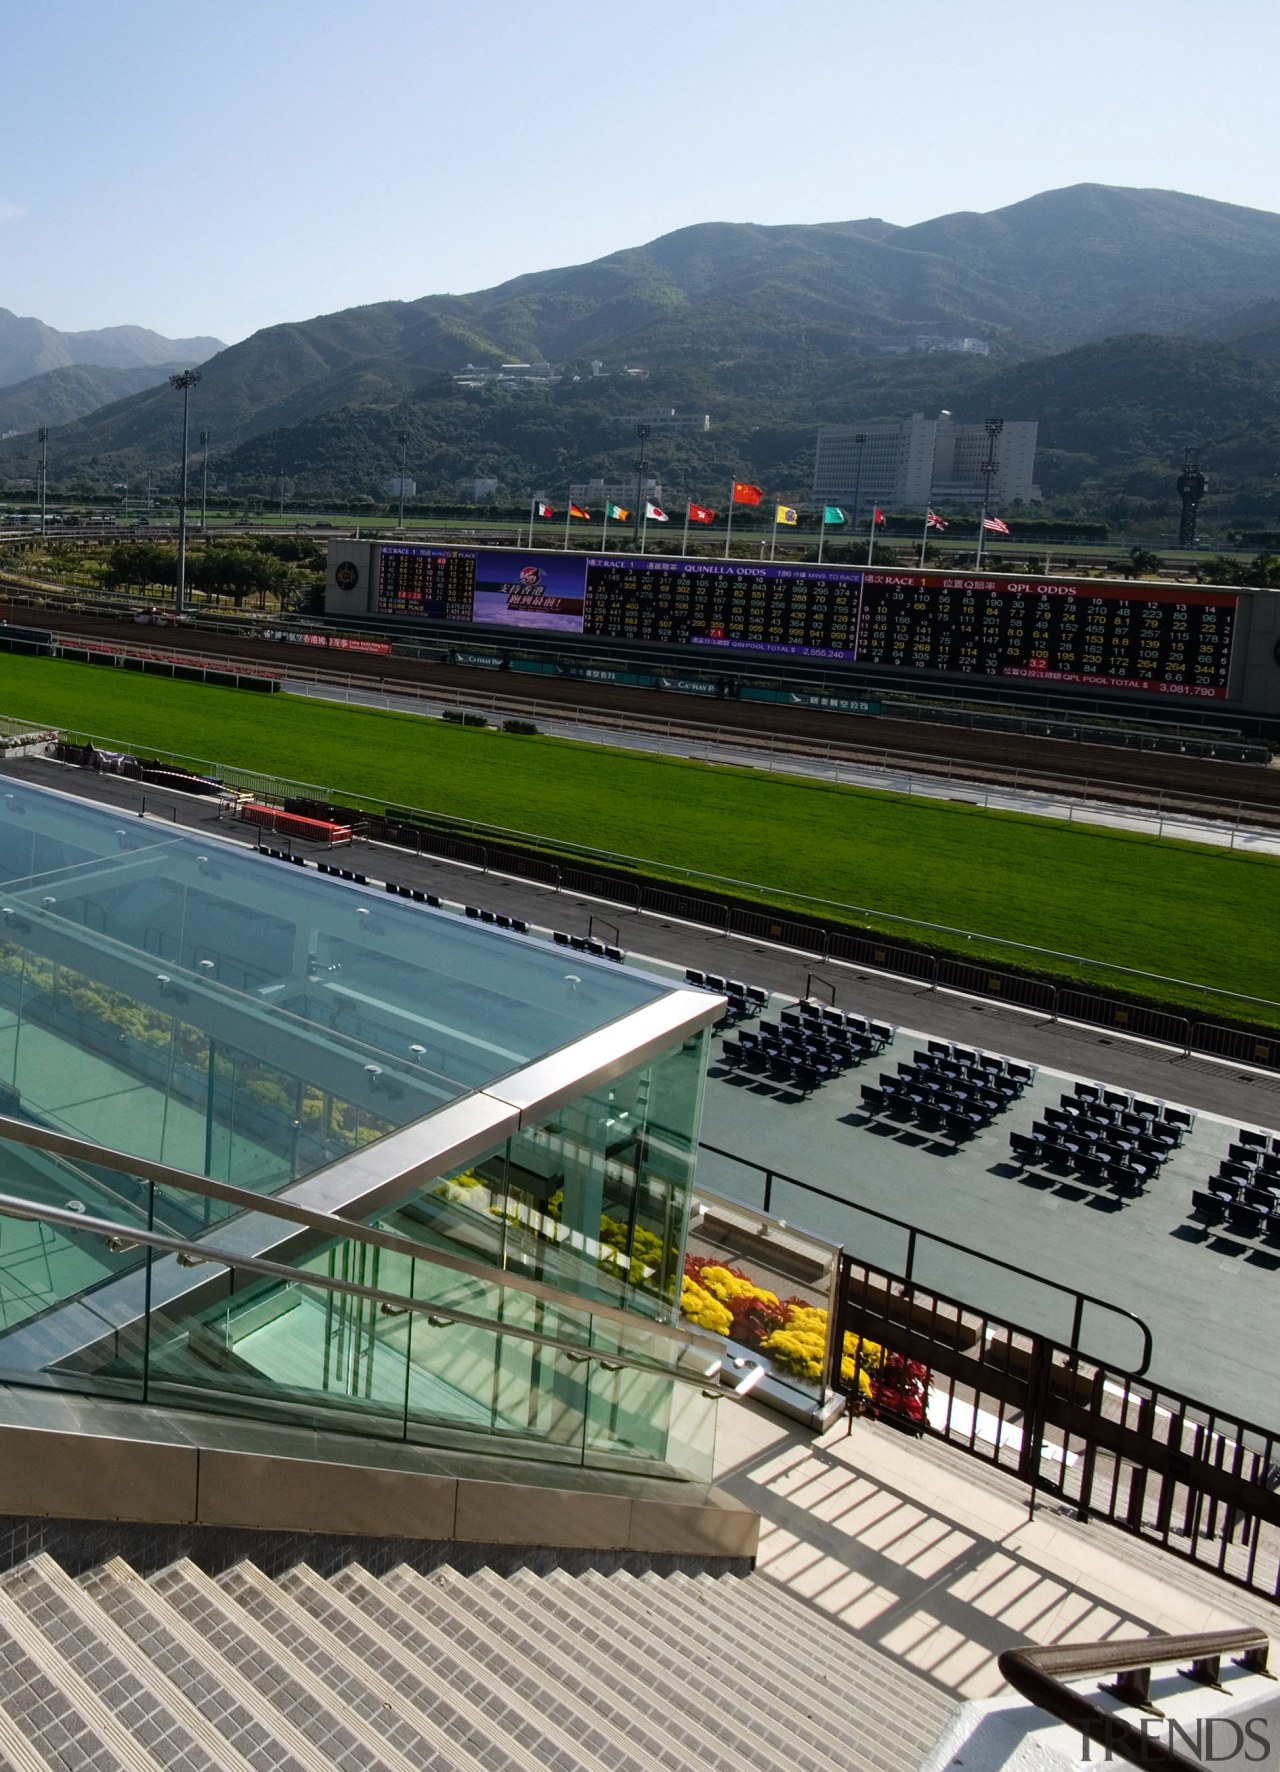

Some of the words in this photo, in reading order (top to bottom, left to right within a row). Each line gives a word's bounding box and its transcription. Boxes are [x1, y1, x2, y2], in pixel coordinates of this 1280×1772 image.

[684, 564, 734, 574] QUINELLA
[736, 567, 766, 576] ODDS
[885, 576, 913, 585] RACE
[920, 578, 925, 586] 1
[1007, 583, 1031, 593] QPL
[1037, 585, 1076, 595] ODDS
[892, 592, 904, 600] 39
[913, 593, 929, 602] 110
[938, 595, 950, 603] 56
[962, 597, 974, 605] 83
[985, 598, 1003, 607] 190
[1012, 600, 1024, 608] 30
[1037, 602, 1050, 610] 35
[1063, 604, 1076, 612] 78
[1087, 605, 1107, 614] 210
[1116, 608, 1130, 616] 48
[1142, 609, 1162, 618] 223
[1172, 611, 1187, 620] 80
[1201, 614, 1216, 622] 96
[938, 604, 949, 612] 12
[986, 607, 998, 615] 84
[1009, 609, 1025, 617] 7.7
[1035, 611, 1051, 619] 7.9
[1062, 613, 1075, 621] 24
[1087, 615, 1106, 623] 170
[1113, 617, 1129, 625] 8.1
[1144, 619, 1158, 627] 79
[1172, 621, 1187, 630] 22
[1201, 623, 1216, 632] 22
[937, 613, 949, 621] 75
[959, 615, 974, 623] 111
[983, 616, 999, 625] 201
[1009, 618, 1022, 627] 58
[1059, 622, 1078, 631] 152
[1085, 624, 1104, 633] 455
[1114, 627, 1128, 635] 87
[1140, 629, 1160, 638] 257
[1169, 631, 1189, 640] 115
[1198, 633, 1218, 643] 178
[983, 626, 998, 634] 141
[1007, 628, 1023, 636] 8.0
[1061, 632, 1073, 640] 17
[1085, 634, 1104, 643] 153
[1111, 637, 1129, 645] 8.8
[1139, 639, 1160, 648] 139
[1171, 642, 1184, 650] 15
[1199, 644, 1213, 653] 35
[982, 635, 999, 643] 147
[1008, 638, 1020, 646] 16
[1034, 640, 1046, 648] 12
[1059, 642, 1072, 651] 28
[1084, 644, 1103, 653] 162
[1113, 647, 1124, 655] 11
[1139, 649, 1158, 658] 109
[1169, 652, 1183, 661] 29
[1006, 647, 1019, 655] 83
[1031, 649, 1049, 658] 109
[1056, 651, 1075, 660] 195
[1082, 654, 1102, 663] 230
[1109, 656, 1129, 666] 172
[1136, 659, 1157, 668] 264
[1165, 661, 1186, 671] 264
[1194, 664, 1215, 674] 344
[1029, 658, 1046, 668] 3.2
[1058, 662, 1070, 670] 13
[1083, 664, 1096, 673] 84
[1108, 666, 1125, 676] 4.8
[1138, 669, 1151, 678] 74
[1164, 672, 1183, 681] 6.6
[1195, 675, 1210, 684] 20
[1062, 673, 1080, 681] QPL
[1082, 675, 1108, 684] POOL
[1110, 678, 1140, 687] TOTAL
